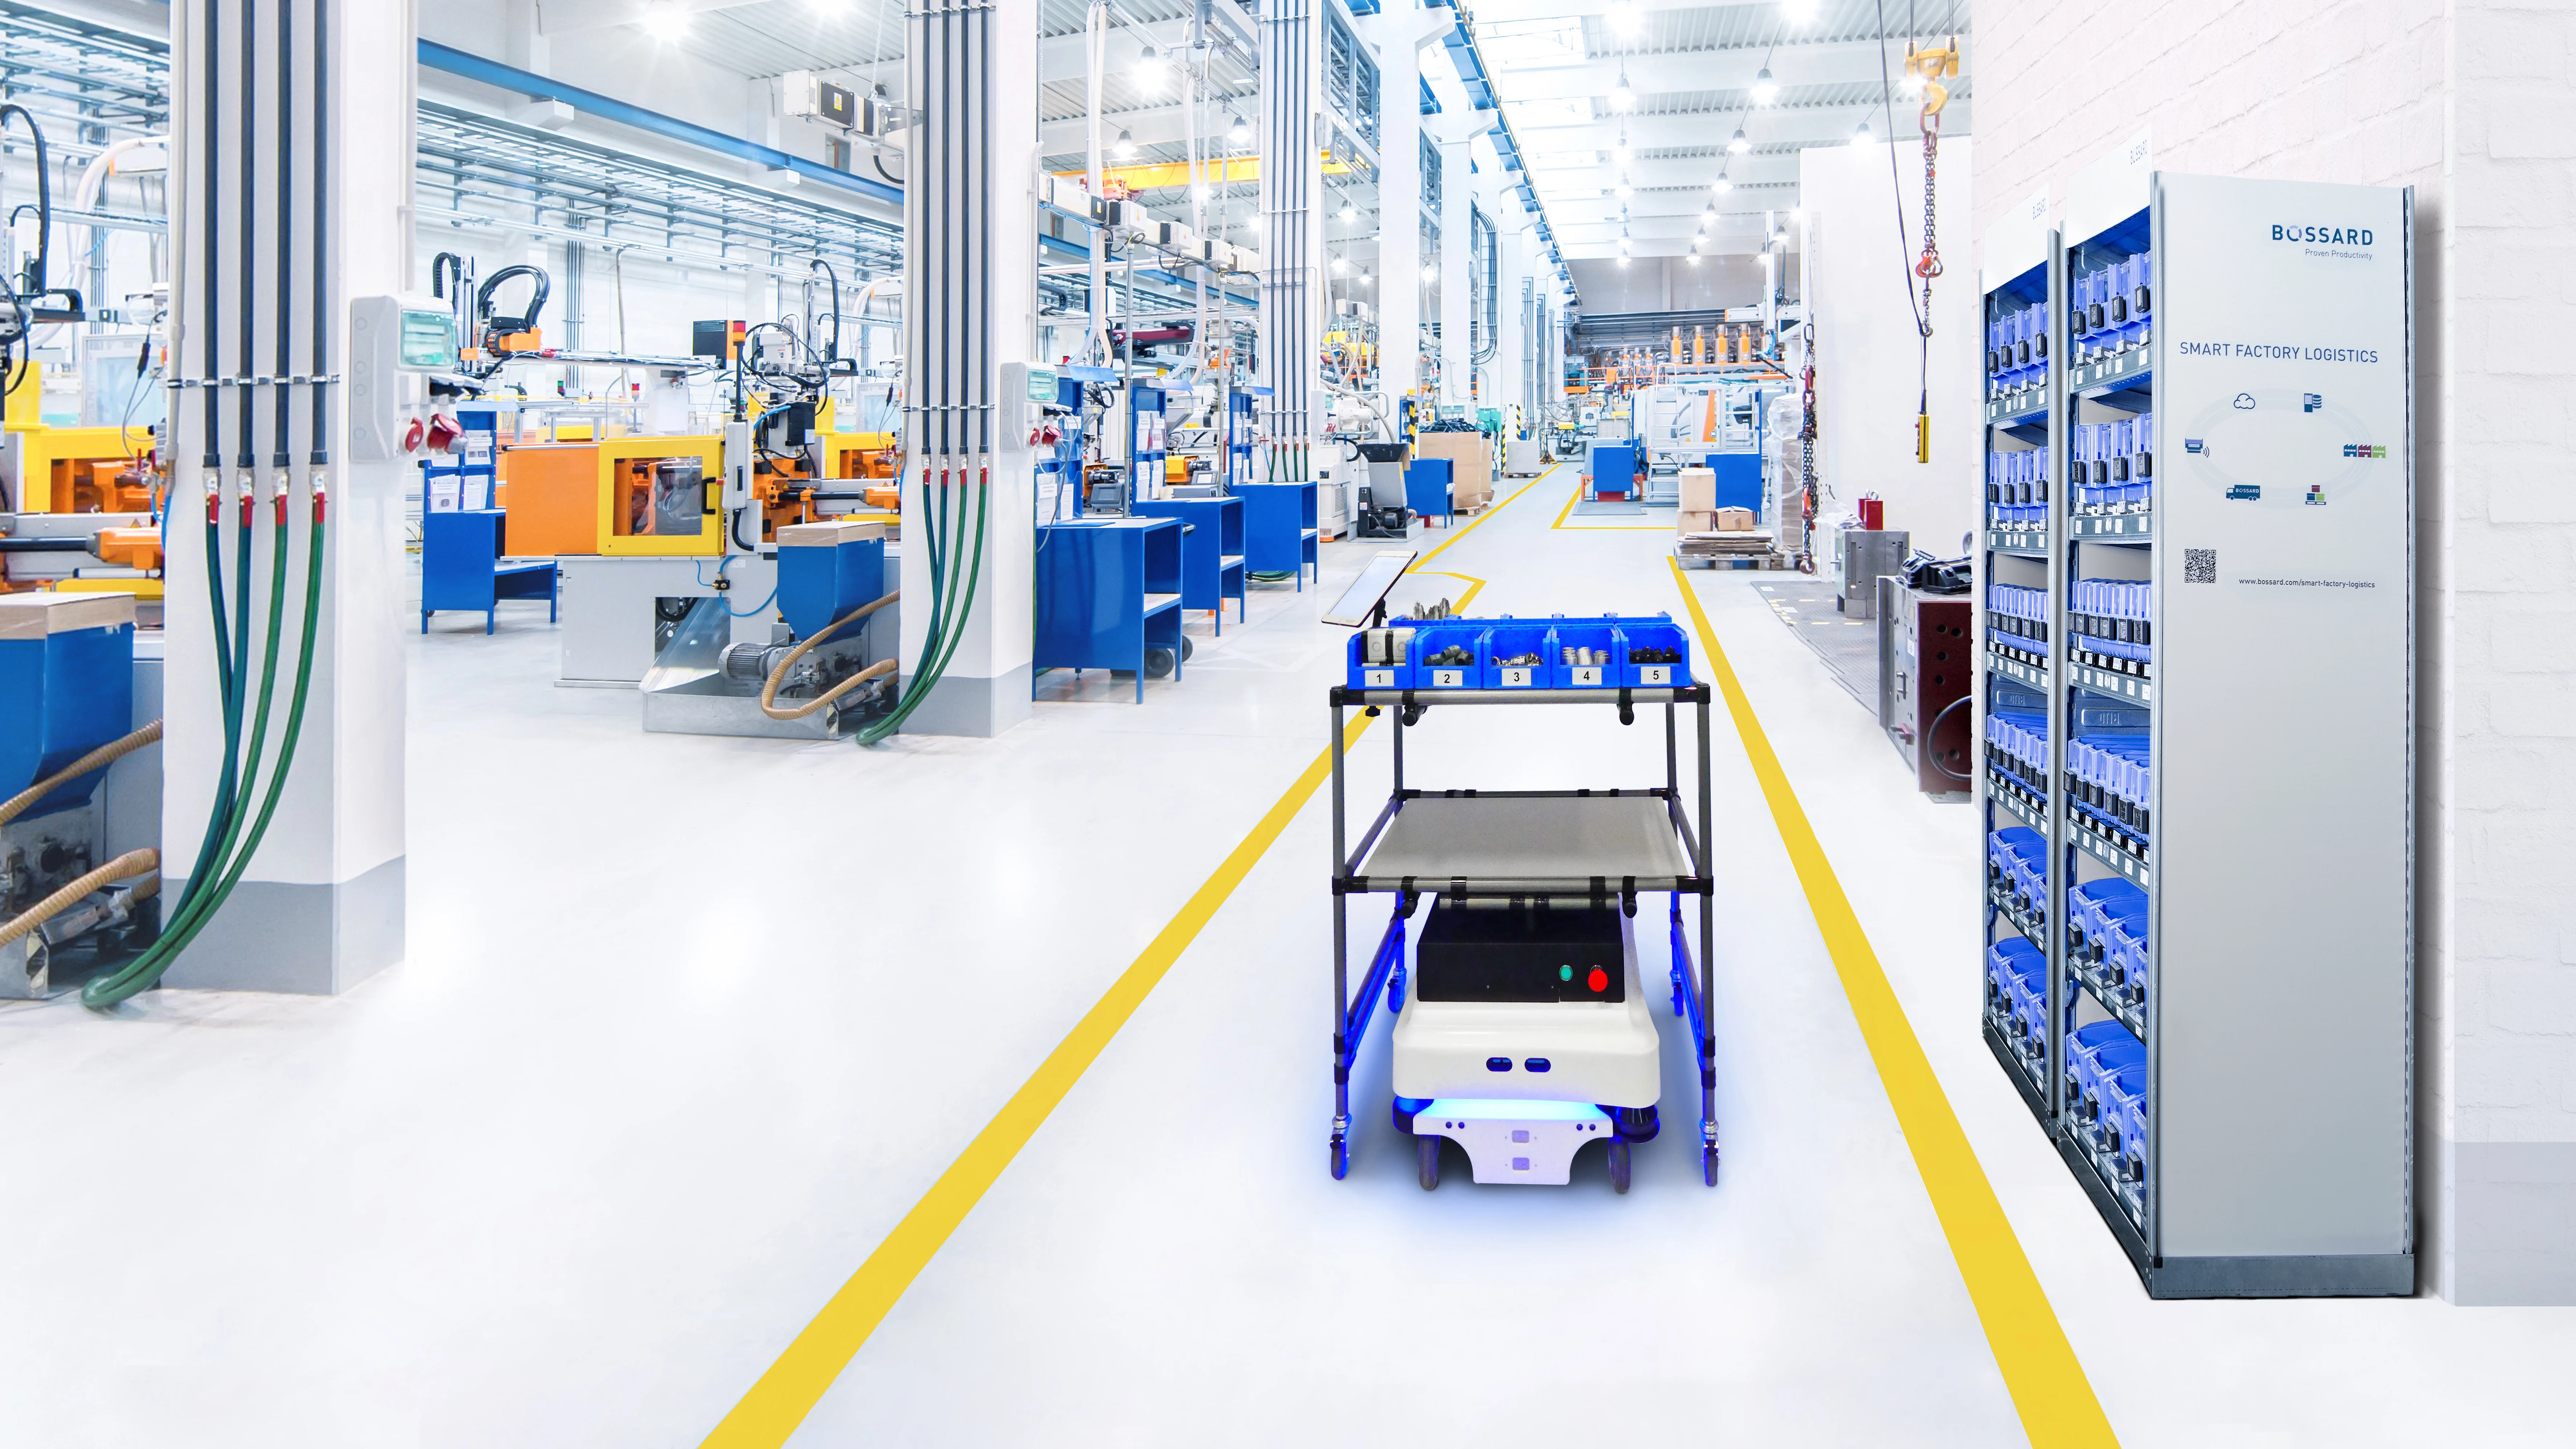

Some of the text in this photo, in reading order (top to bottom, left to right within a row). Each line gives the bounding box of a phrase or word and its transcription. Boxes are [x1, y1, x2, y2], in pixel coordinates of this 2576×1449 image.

[2272, 224, 2373, 246] BOSSARD
[2305, 248, 2373, 261] Proven Productivity
[2180, 342, 2378, 363] SMART FACTORY LOGISTICS
[2239, 578, 2375, 589] www.bossard.com/smart-factory-logistics
[1376, 673, 1381, 683] 1
[1444, 674, 1450, 683] 2
[1514, 672, 1520, 682] 3
[1583, 671, 1590, 681] 4
[1653, 670, 1659, 680] 5
